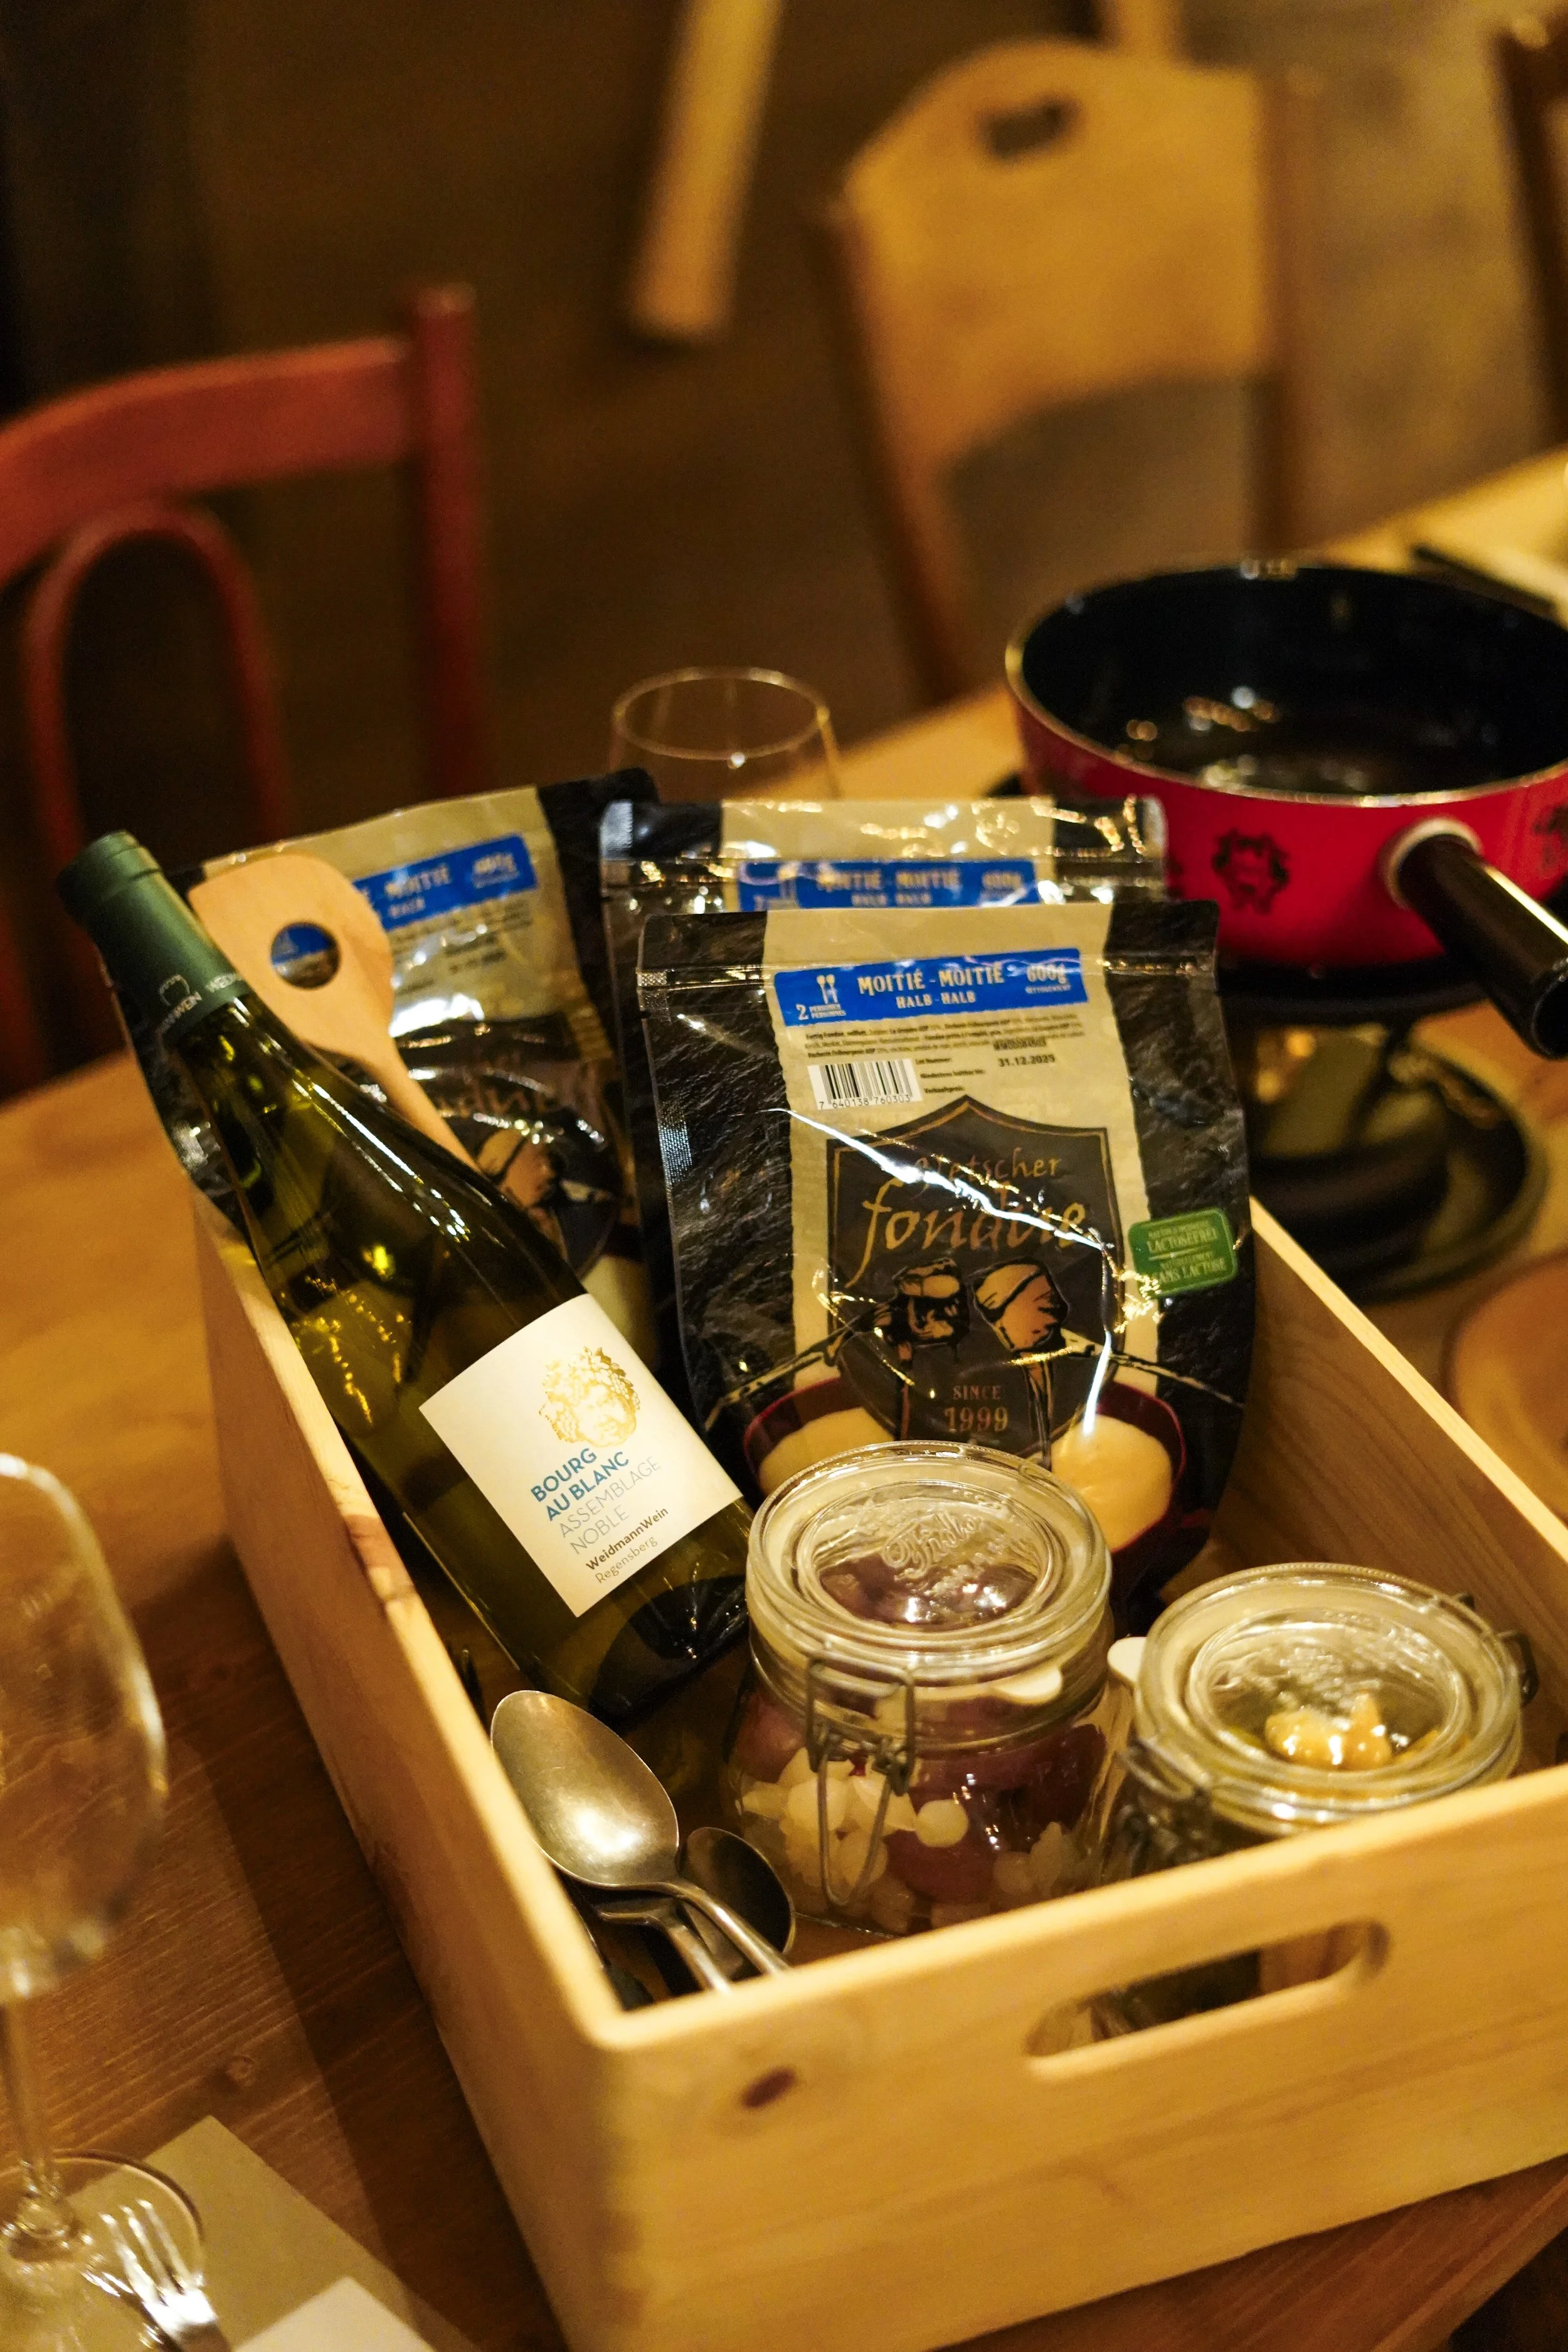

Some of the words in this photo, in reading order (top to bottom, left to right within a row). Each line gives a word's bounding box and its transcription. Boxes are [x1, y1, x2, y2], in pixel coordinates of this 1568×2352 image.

[857, 968, 926, 996] MOITIÉ
[938, 961, 1005, 987] MOITIÉ
[796, 1004, 808, 1020] 2
[896, 993, 933, 1009] HALB
[941, 990, 977, 1005] HALB
[998, 1054, 1055, 1067] 31.12.2025
[819, 1101, 824, 1110] 7
[833, 1098, 870, 1109] 640138
[875, 1095, 910, 1104] 760303
[845, 1177, 1094, 1289] fondue
[953, 1385, 1002, 1400] SINCE
[943, 1406, 1009, 1434] 1999
[531, 1448, 597, 1502] BOURG
[546, 1493, 570, 1521] AU
[568, 1451, 629, 1500] BLANC
[559, 1456, 660, 1538] ASSEMBLAGE
[570, 1505, 629, 1555] NOBLE
[585, 1507, 669, 1570] WeidmannWein
[595, 1537, 658, 1584] Regensberg
